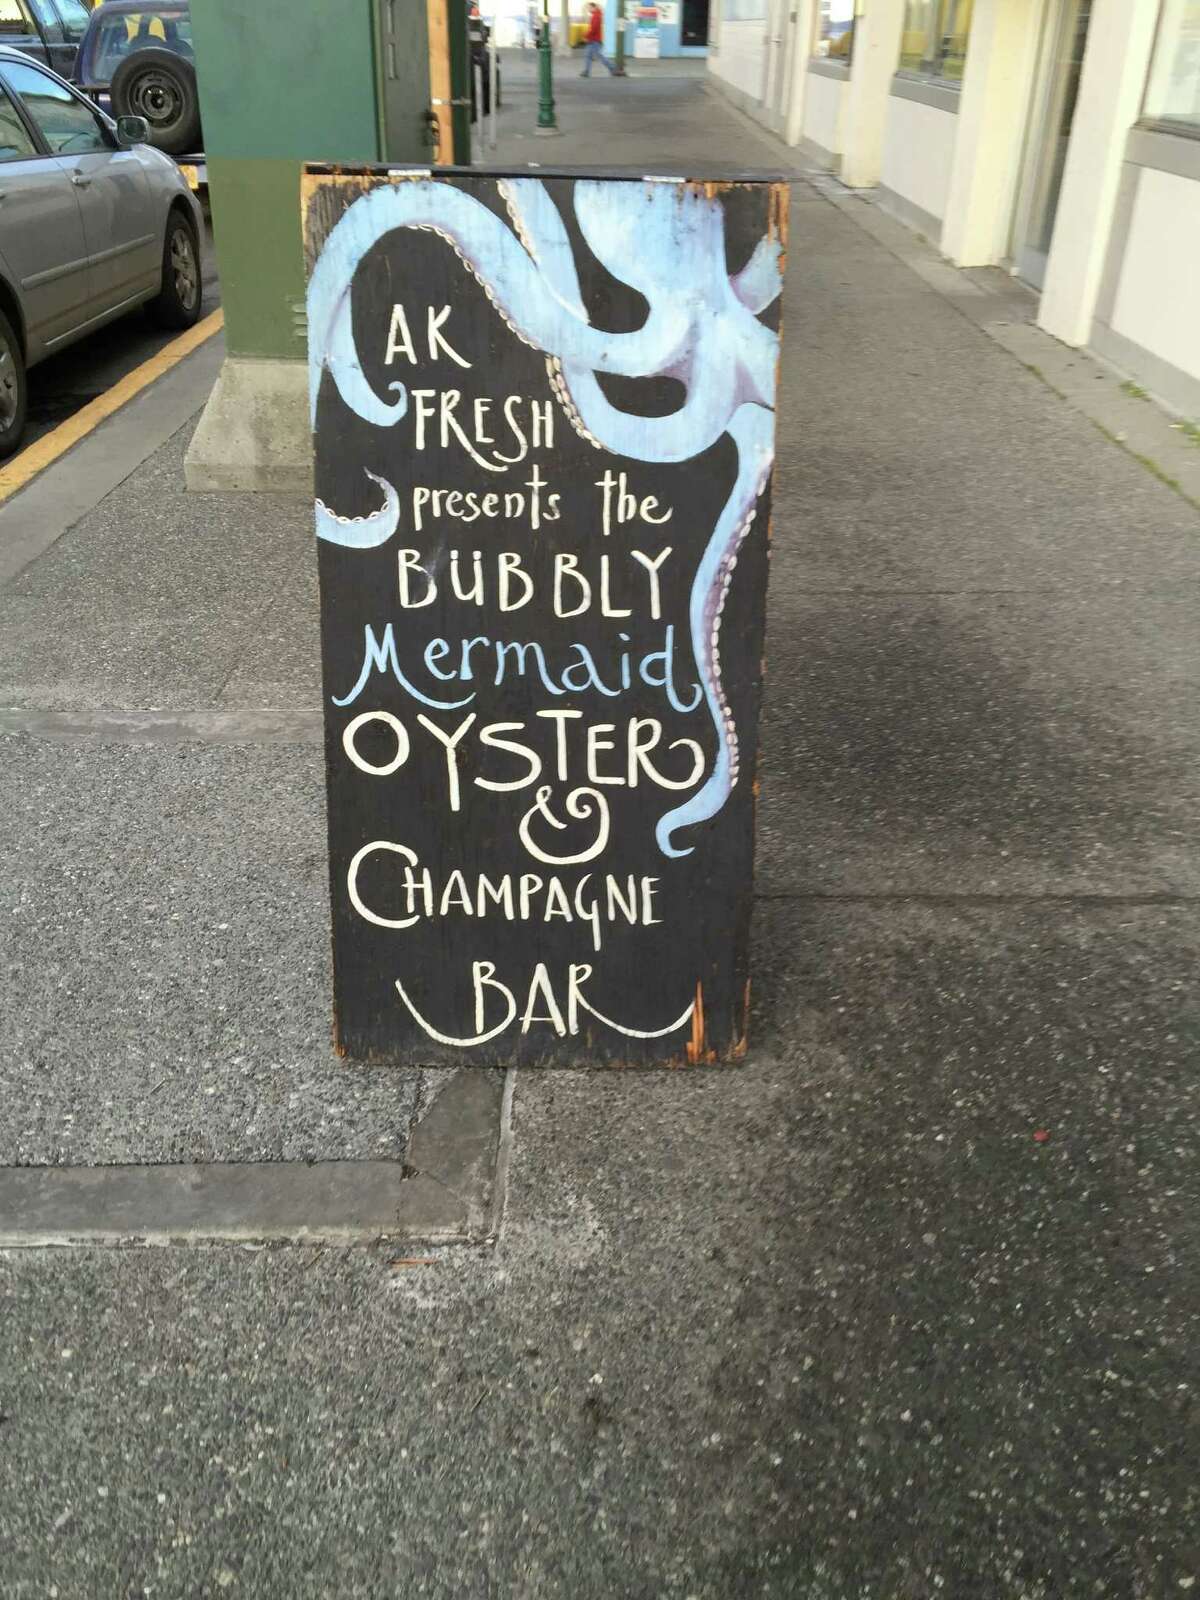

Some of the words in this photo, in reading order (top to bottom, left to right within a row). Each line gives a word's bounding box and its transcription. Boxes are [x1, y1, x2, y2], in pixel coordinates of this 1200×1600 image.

[384, 304, 472, 368] AK
[411, 389, 554, 472] FRESH
[413, 464, 561, 531] presents
[595, 470, 673, 536] the
[398, 546, 673, 620] BUBBLY
[332, 623, 702, 713] Mermaid
[342, 709, 705, 812] OYSTER
[518, 785, 610, 865] &
[347, 840, 664, 951] CHAMPAGNE
[395, 961, 696, 1046] BAR
